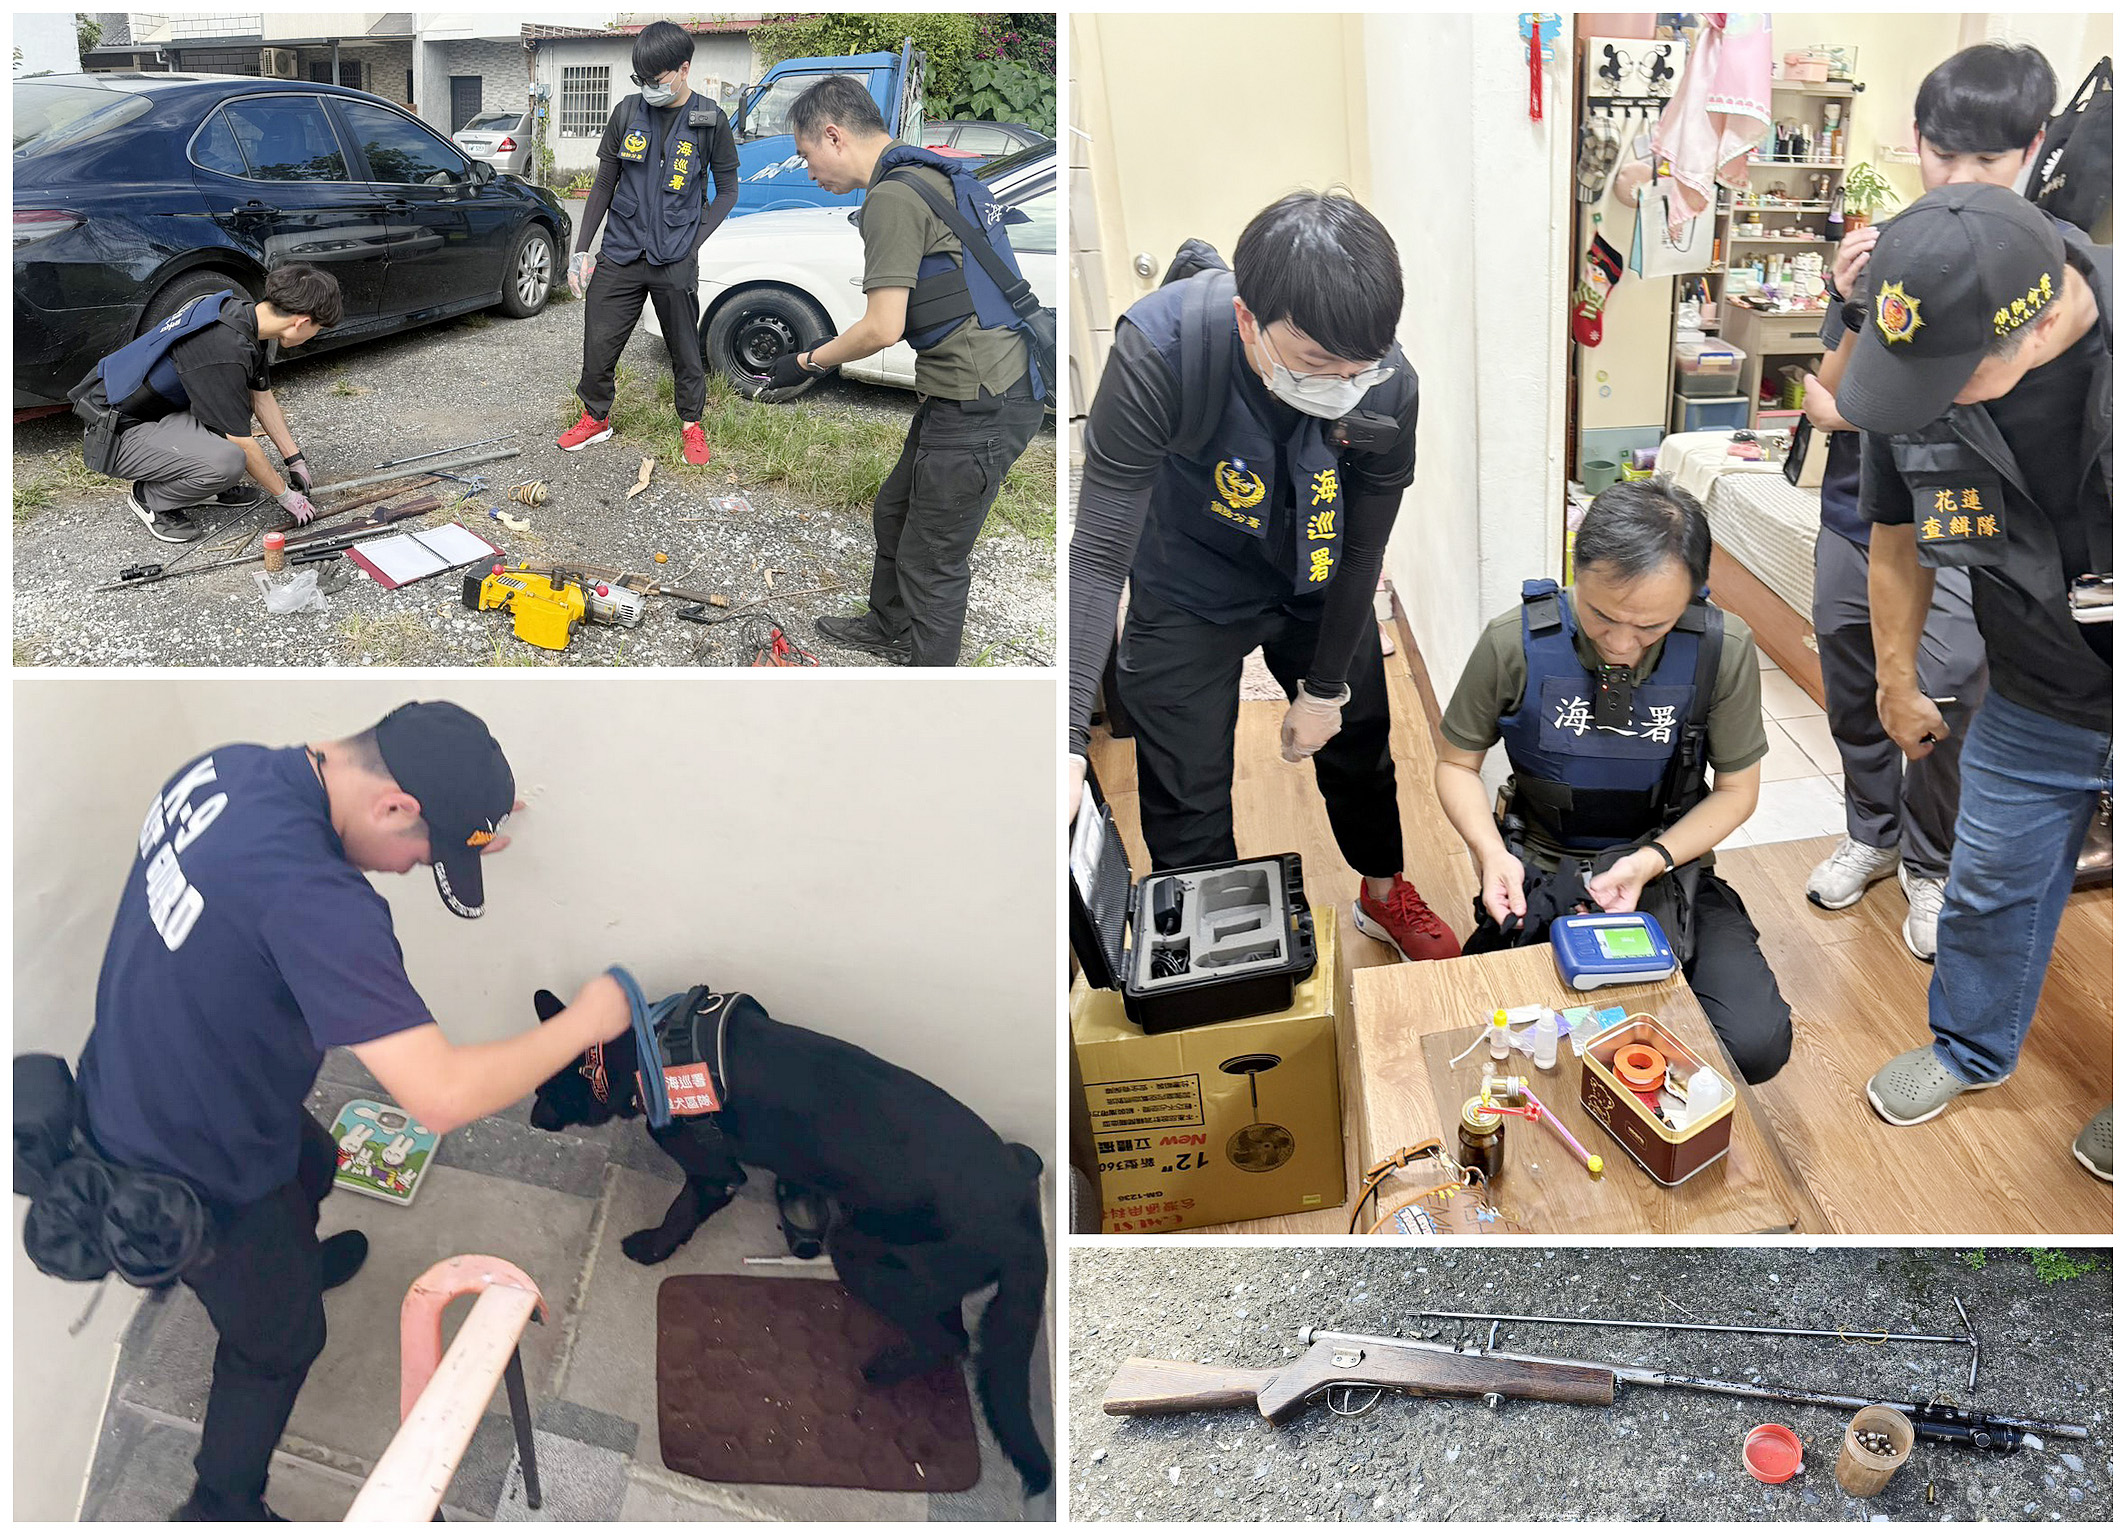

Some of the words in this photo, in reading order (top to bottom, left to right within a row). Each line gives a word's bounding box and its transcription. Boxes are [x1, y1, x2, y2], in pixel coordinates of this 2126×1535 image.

[668, 140, 693, 190] 海巡署
[1934, 487, 1985, 513] 花蓮
[1306, 469, 1339, 582] 海巡署
[1921, 514, 2001, 539] 查緝隊
[163, 756, 229, 855] K-9
[665, 1072, 706, 1091] 海巡署
[1160, 1133, 1207, 1147] New
